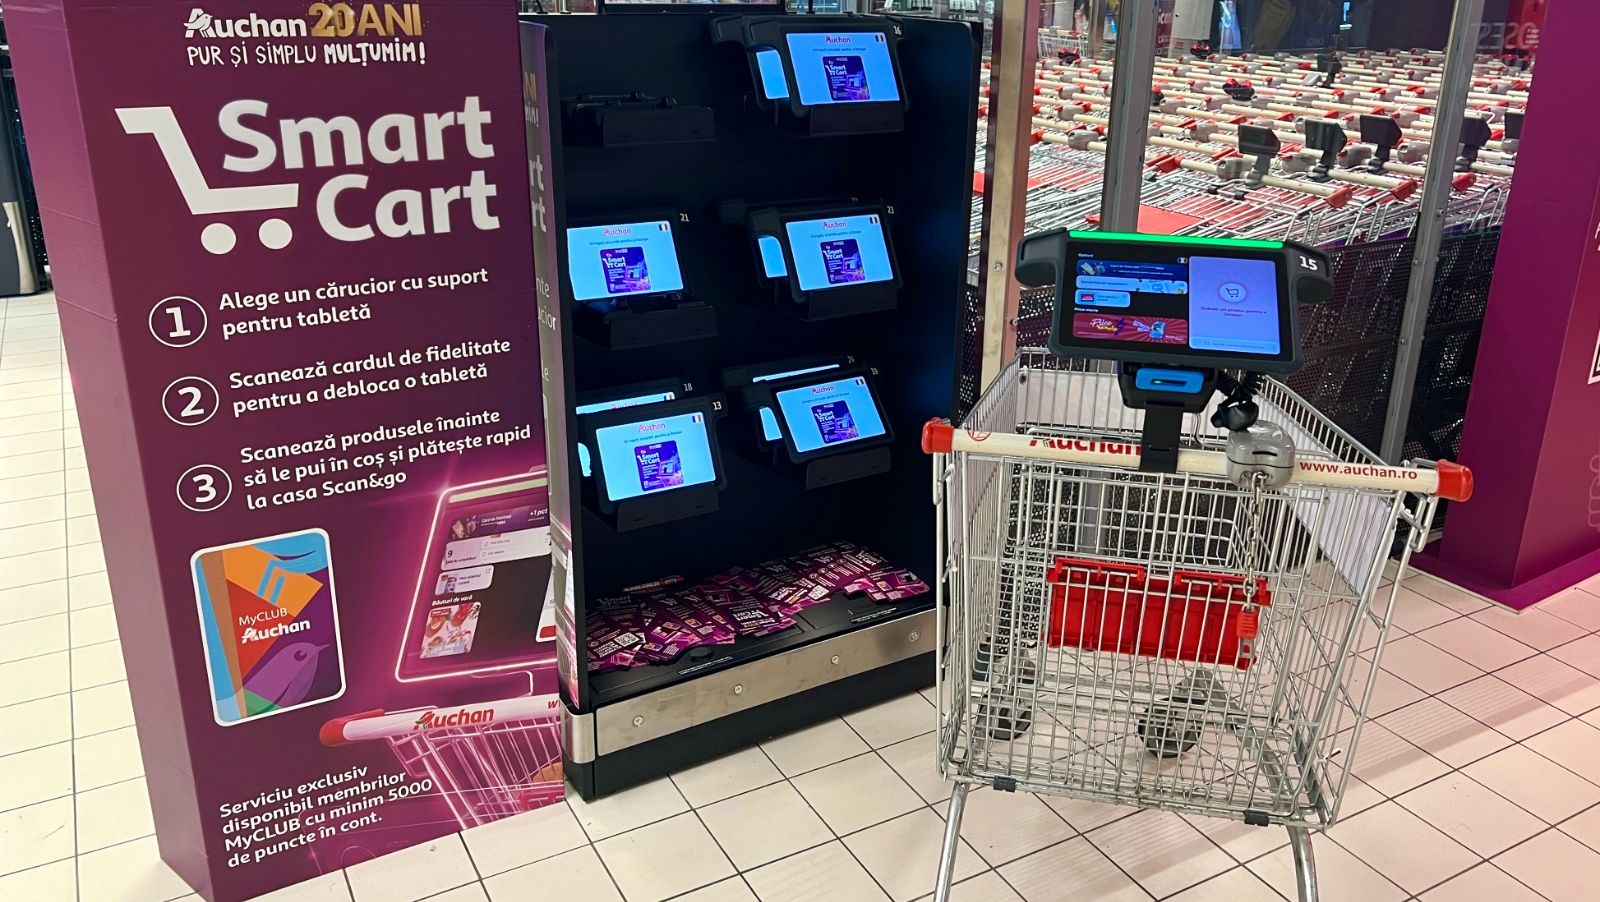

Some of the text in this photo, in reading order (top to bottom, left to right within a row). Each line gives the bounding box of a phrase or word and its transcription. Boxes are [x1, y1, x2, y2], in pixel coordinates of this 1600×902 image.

[184, 8, 307, 38] Auchan
[186, 46, 224, 66] PUR
[218, 96, 494, 172] Smart
[316, 170, 500, 242] Cart
[680, 213, 689, 222] 21
[1300, 256, 1318, 271] 15
[220, 268, 488, 310] Alege un cărucior cu suport
[166, 306, 190, 338] 1
[222, 304, 370, 340] pentru tabletă
[230, 340, 510, 388] Scanează cardul de fidelitate
[178, 386, 204, 418] 2
[234, 362, 488, 418] pentru a debloca o tabletă
[712, 401, 722, 411] 13
[240, 410, 500, 464] Scanează produsele înainte
[244, 424, 530, 486] să le pui în coș și plătește rapid
[192, 474, 216, 502] 3
[1300, 462, 1417, 480] www.auchan.ro
[246, 472, 406, 510] la casa Scan&go
[238, 608, 288, 626] MyCLUB
[241, 620, 310, 644] Auchan
[414, 708, 494, 731] Auchan
[220, 764, 368, 818] Serviciu exclusiv
[222, 771, 406, 834] disponibil membrilor
[224, 778, 432, 852] MyCLUB cu minim 5000
[228, 811, 382, 868] de puncte în cont.
